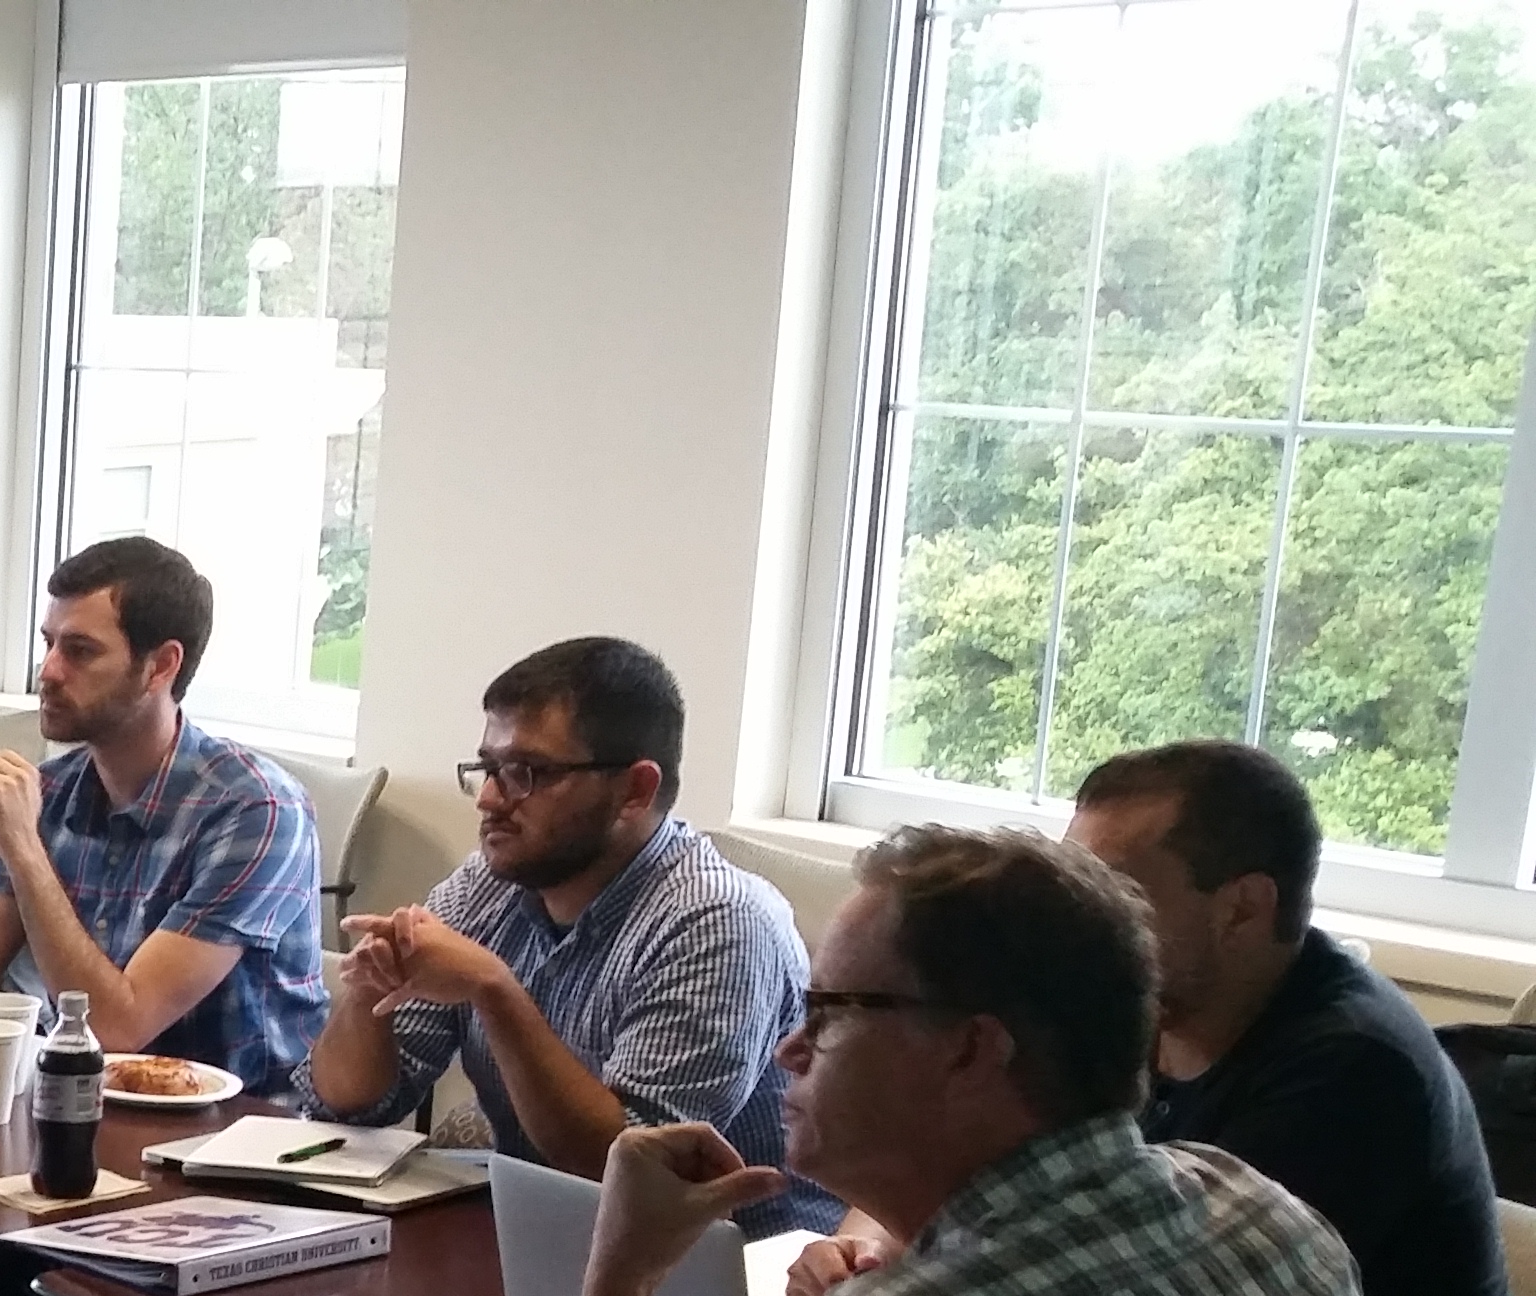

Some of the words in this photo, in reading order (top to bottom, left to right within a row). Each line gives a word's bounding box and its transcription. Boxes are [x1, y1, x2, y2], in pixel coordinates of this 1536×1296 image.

[209, 1261, 243, 1280] TEXAS
[245, 1251, 298, 1273] CHRISTIAN
[301, 1237, 360, 1261] UNIVERSITY
